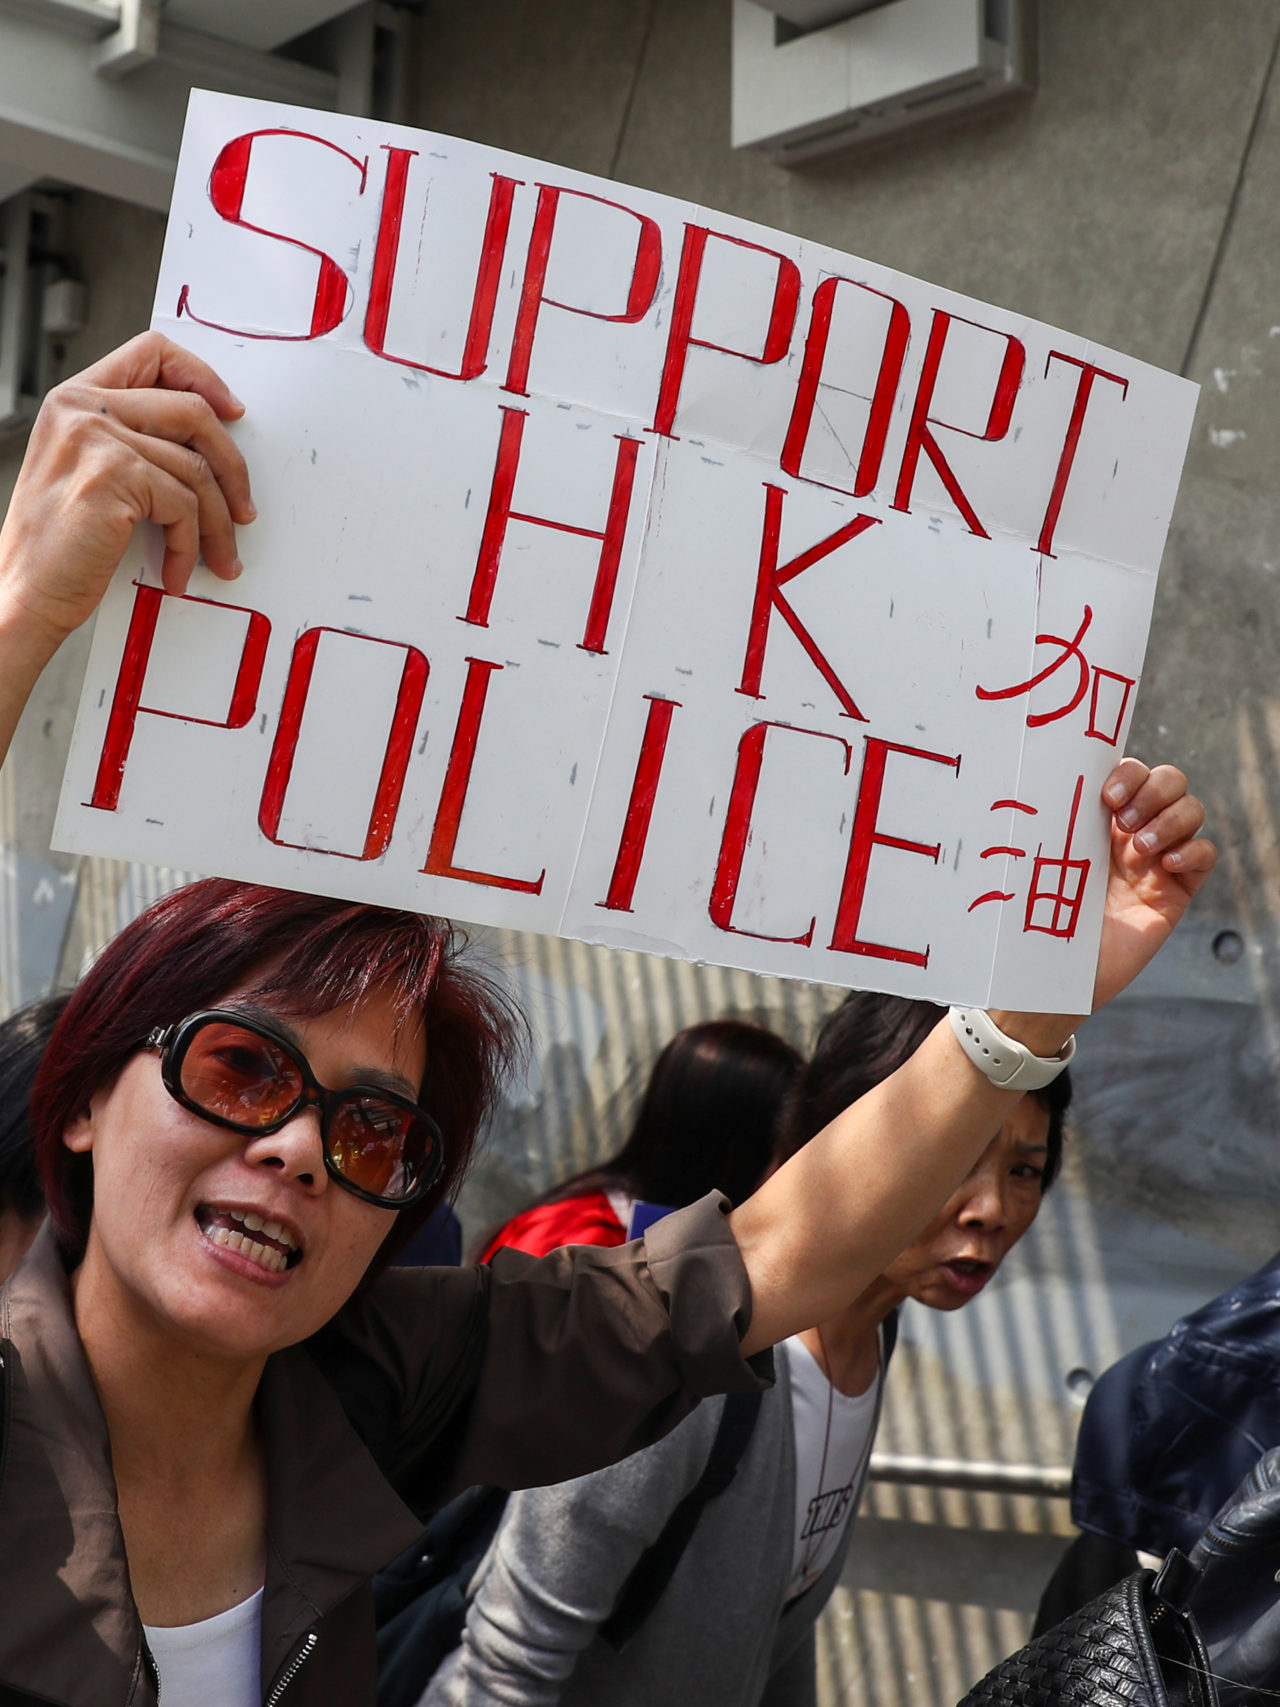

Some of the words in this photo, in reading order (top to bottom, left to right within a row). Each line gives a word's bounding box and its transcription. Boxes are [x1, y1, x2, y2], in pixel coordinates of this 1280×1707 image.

[177, 127, 1129, 557] SUPPORT
[81, 578, 961, 968] POLICE
[968, 605, 1136, 941] 加油
